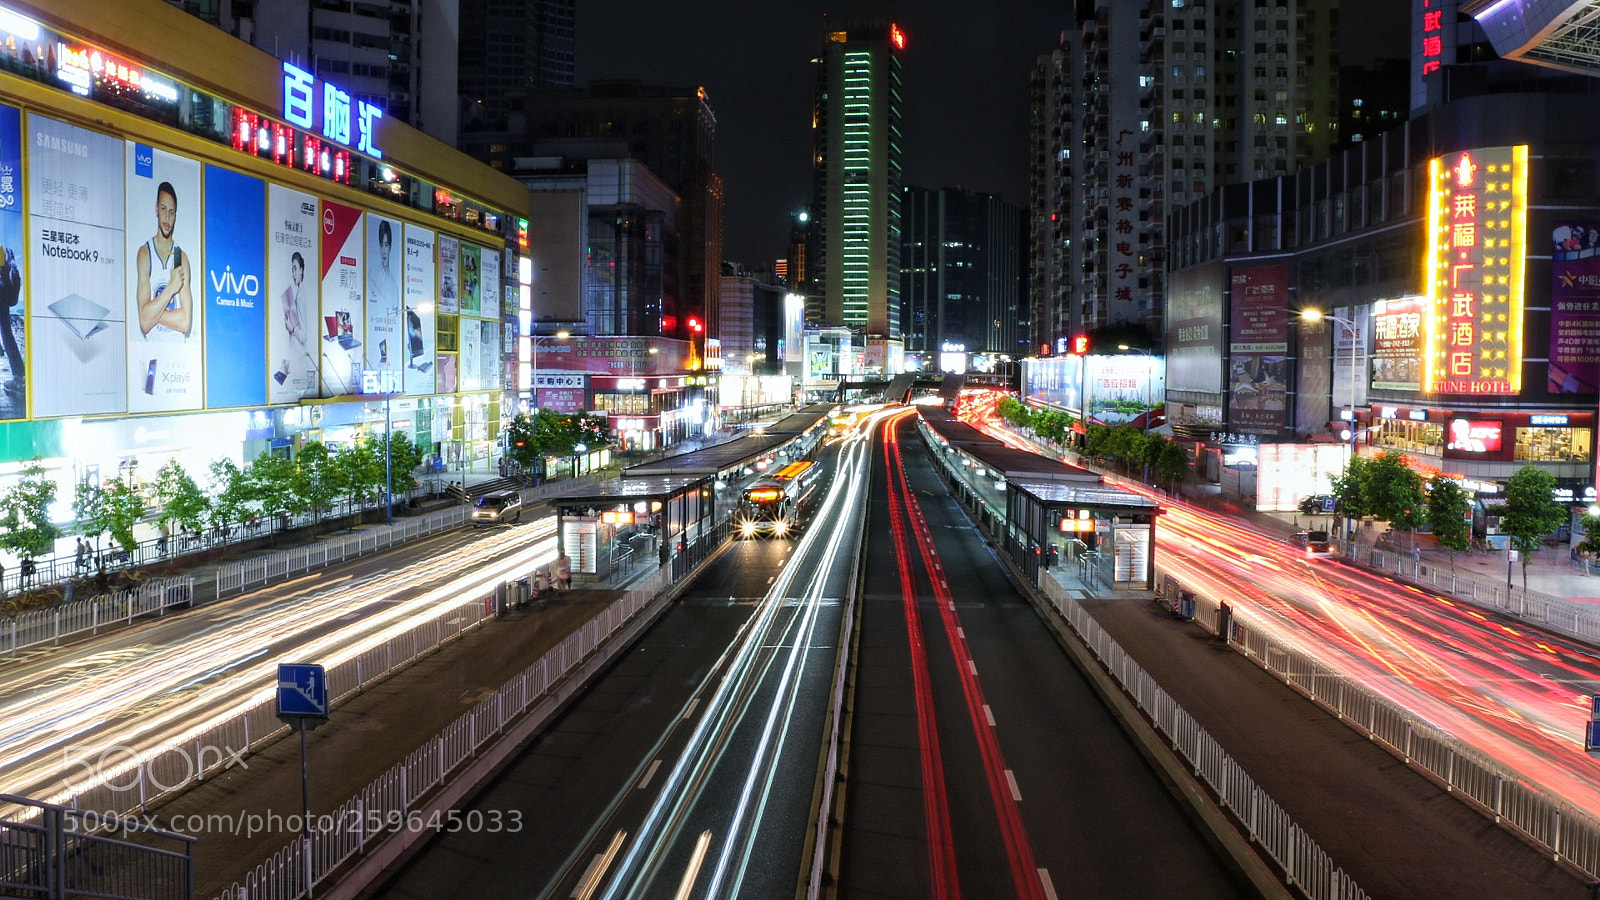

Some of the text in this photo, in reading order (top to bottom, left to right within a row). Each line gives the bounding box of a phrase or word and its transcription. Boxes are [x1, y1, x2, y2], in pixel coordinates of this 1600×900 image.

[283, 61, 383, 159] 百脑汇
[37, 133, 88, 158] SAMSUNG
[137, 154, 152, 163] vivo
[1116, 130, 1134, 301] 广州新赛格电子城
[324, 217, 334, 226] DELL
[42, 229, 80, 244] 三星笔记本
[42, 243, 92, 262] Notebook
[93, 250, 99, 262] 9
[211, 265, 259, 296] vivo
[1578, 275, 1600, 285] 中影
[216, 296, 235, 306] Camera
[236, 298, 240, 306] &
[531, 377, 574, 386] 采购中心
[1098, 378, 1137, 388] 广告位招租
[1471, 381, 1515, 393] HOTEL
[1325, 499, 1333, 508] P
